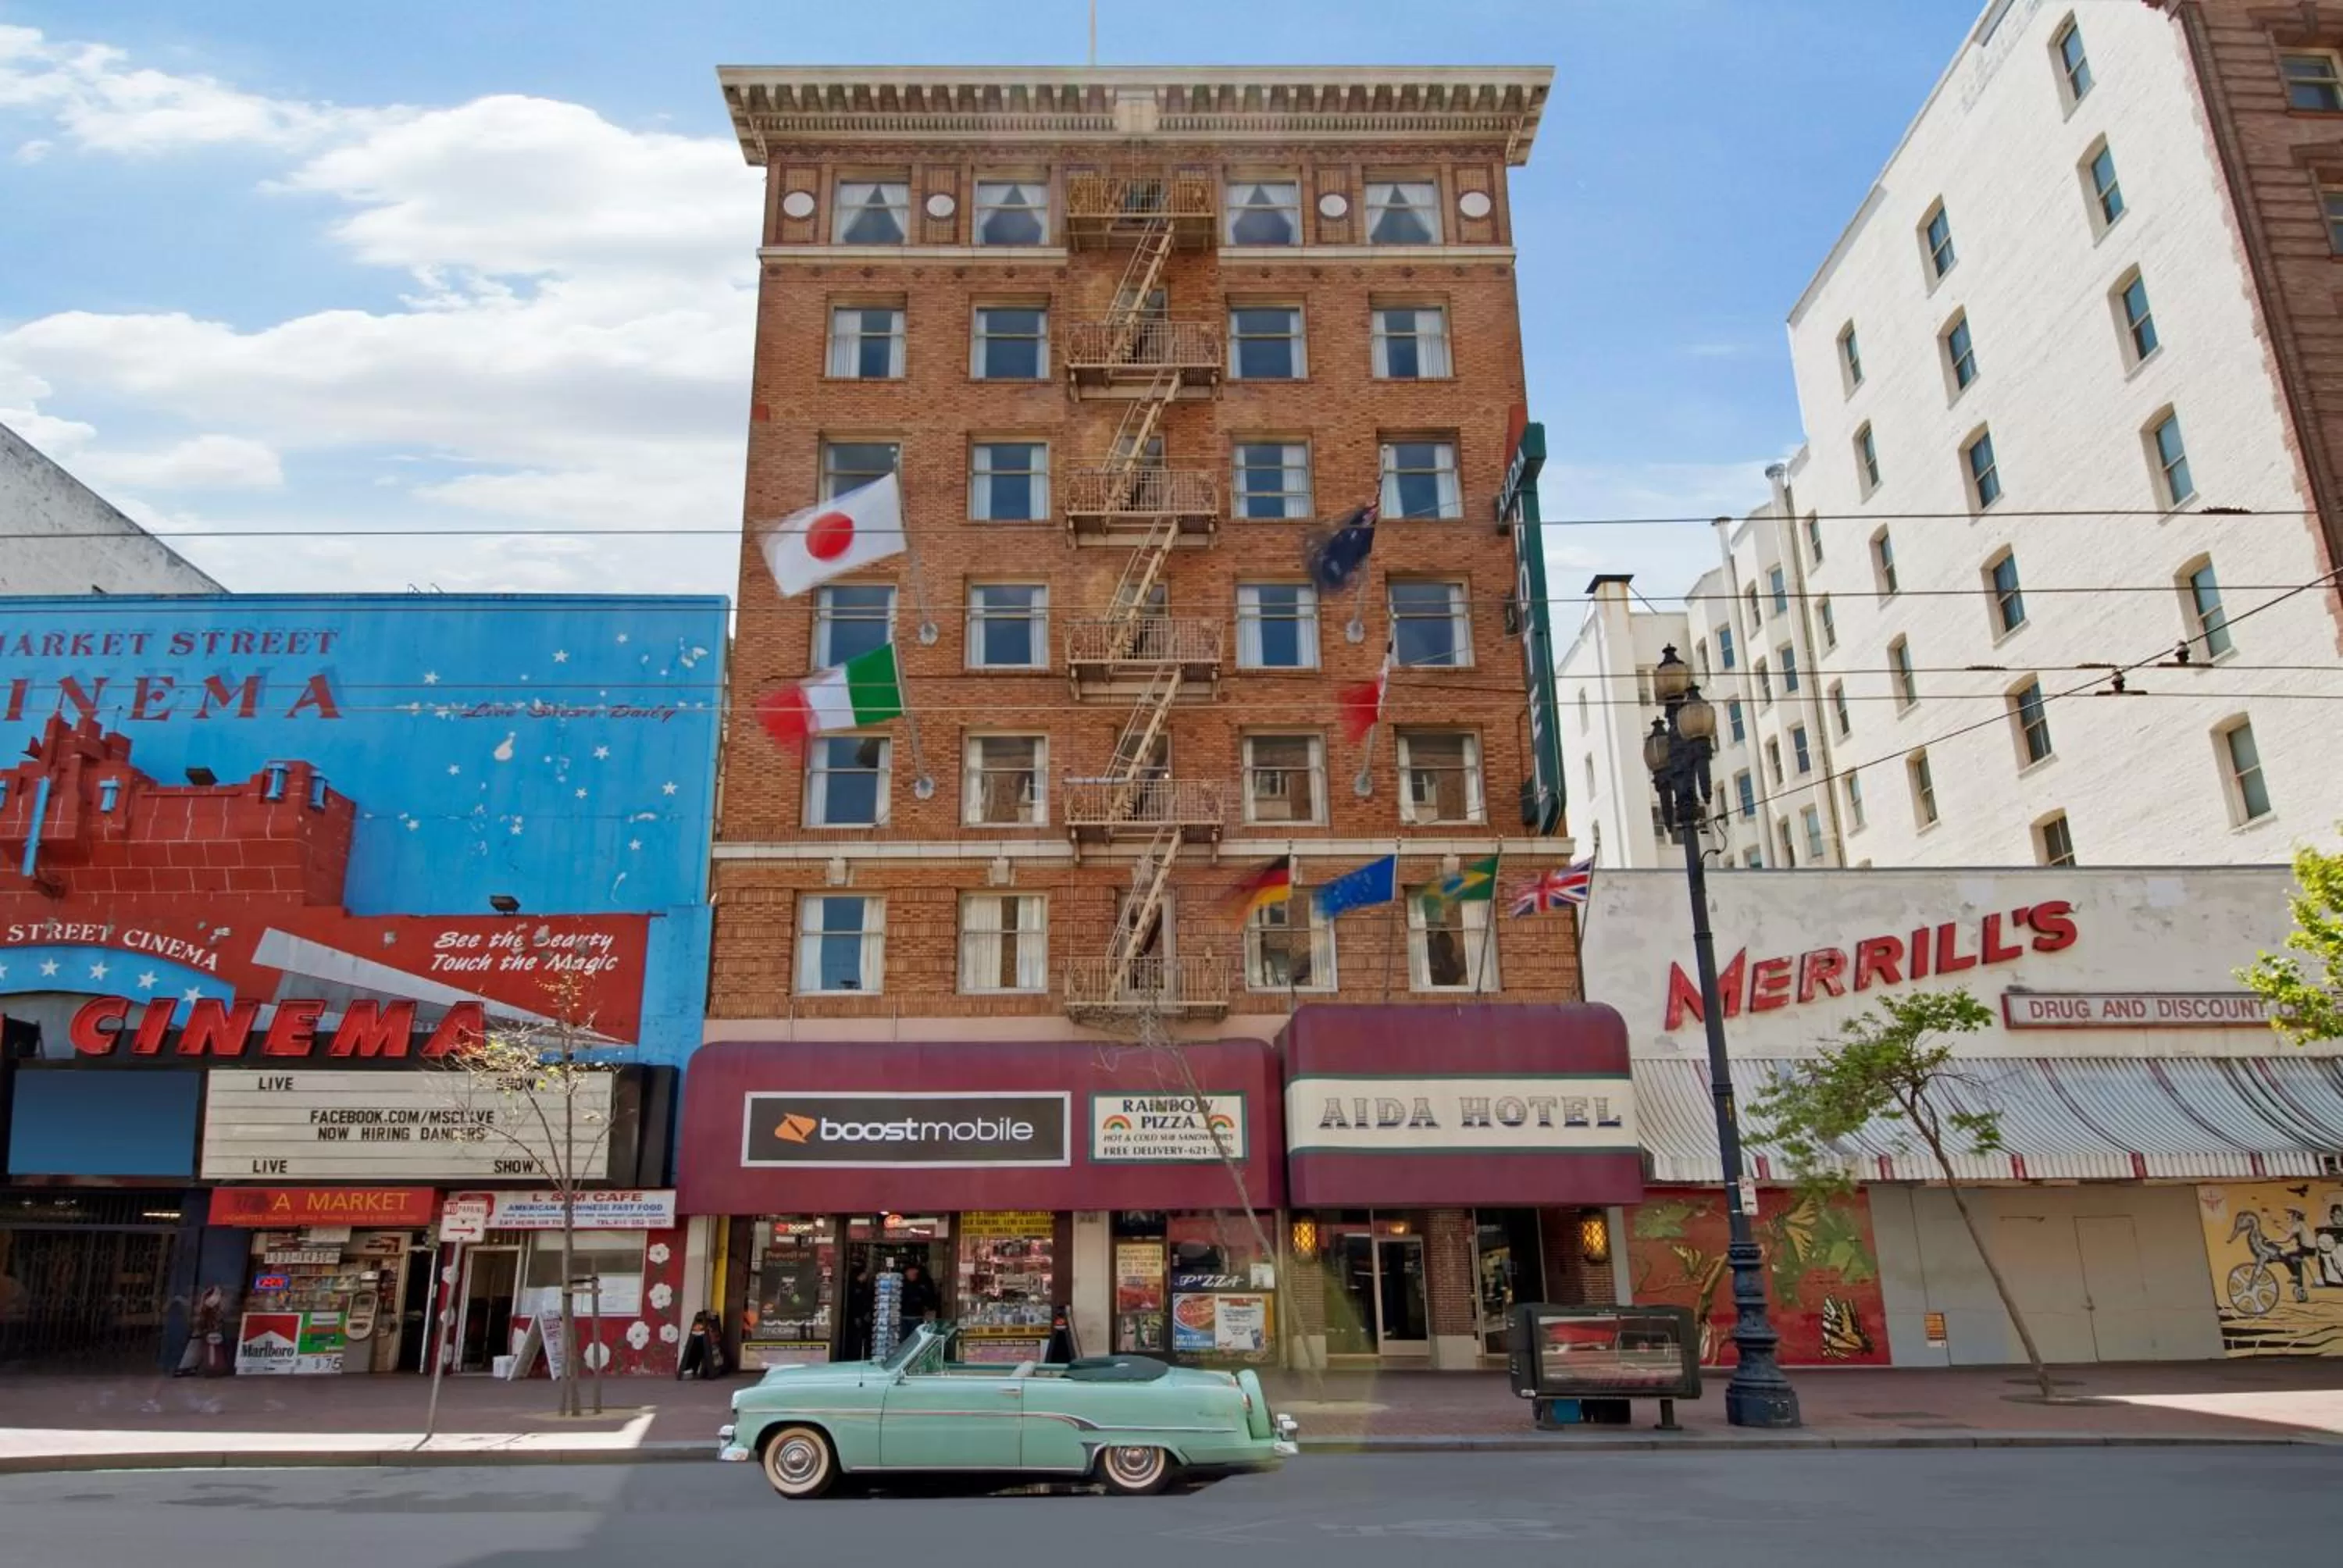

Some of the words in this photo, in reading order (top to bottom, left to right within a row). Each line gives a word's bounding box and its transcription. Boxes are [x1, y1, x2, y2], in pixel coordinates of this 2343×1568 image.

[0, 631, 153, 657] ARKET
[168, 629, 339, 656] STREET
[1513, 494, 1549, 803] HOTEL
[7, 924, 114, 942] STREET
[123, 928, 219, 972] CINEMA
[434, 932, 482, 949] See
[489, 931, 525, 949] the
[431, 953, 494, 971] Touch
[500, 955, 537, 971] the
[544, 953, 619, 975] Magic
[1664, 900, 2078, 1032] MERRILL'S
[2031, 1000, 2090, 1018] DRUG
[2102, 1000, 2146, 1018] AND
[2157, 999, 2268, 1018] DISCOUNT
[70, 996, 485, 1057] CINEMA
[259, 1077, 294, 1090] LIVE
[1318, 1097, 1440, 1128] AIDA
[1459, 1096, 1623, 1128] HOTEL
[1141, 1116, 1196, 1129] PIZZA
[318, 1127, 350, 1141] NOW
[362, 1127, 411, 1141] HIRING
[1133, 1133, 1158, 1142] COLD
[1104, 1146, 1129, 1156] FREE
[252, 1160, 288, 1173] LIVE
[494, 1160, 534, 1174] SHOW
[273, 1192, 291, 1210] A
[307, 1192, 413, 1210] MARKET
[532, 1193, 543, 1203] L
[594, 1192, 644, 1202] CAFE
[243, 1342, 294, 1358] Marlboro
